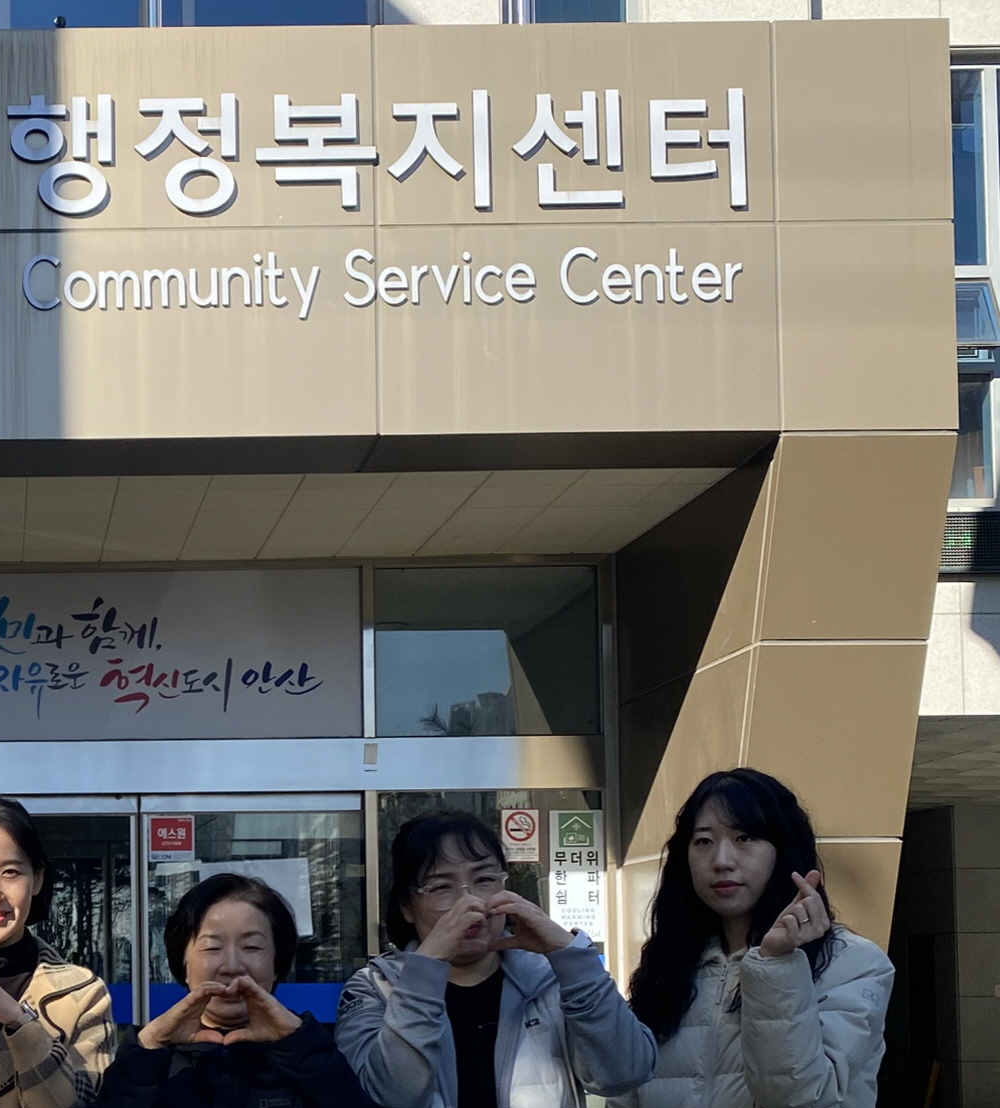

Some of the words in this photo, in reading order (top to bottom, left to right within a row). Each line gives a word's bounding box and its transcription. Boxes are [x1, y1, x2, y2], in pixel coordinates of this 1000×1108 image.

[22, 251, 321, 320] Community
[344, 248, 536, 305] Service
[560, 246, 744, 304] Center
[100, 657, 233, 714] 혁신도시
[242, 661, 324, 694] 안산
[157, 828, 186, 840] 에스원
[554, 851, 599, 866] 무더위
